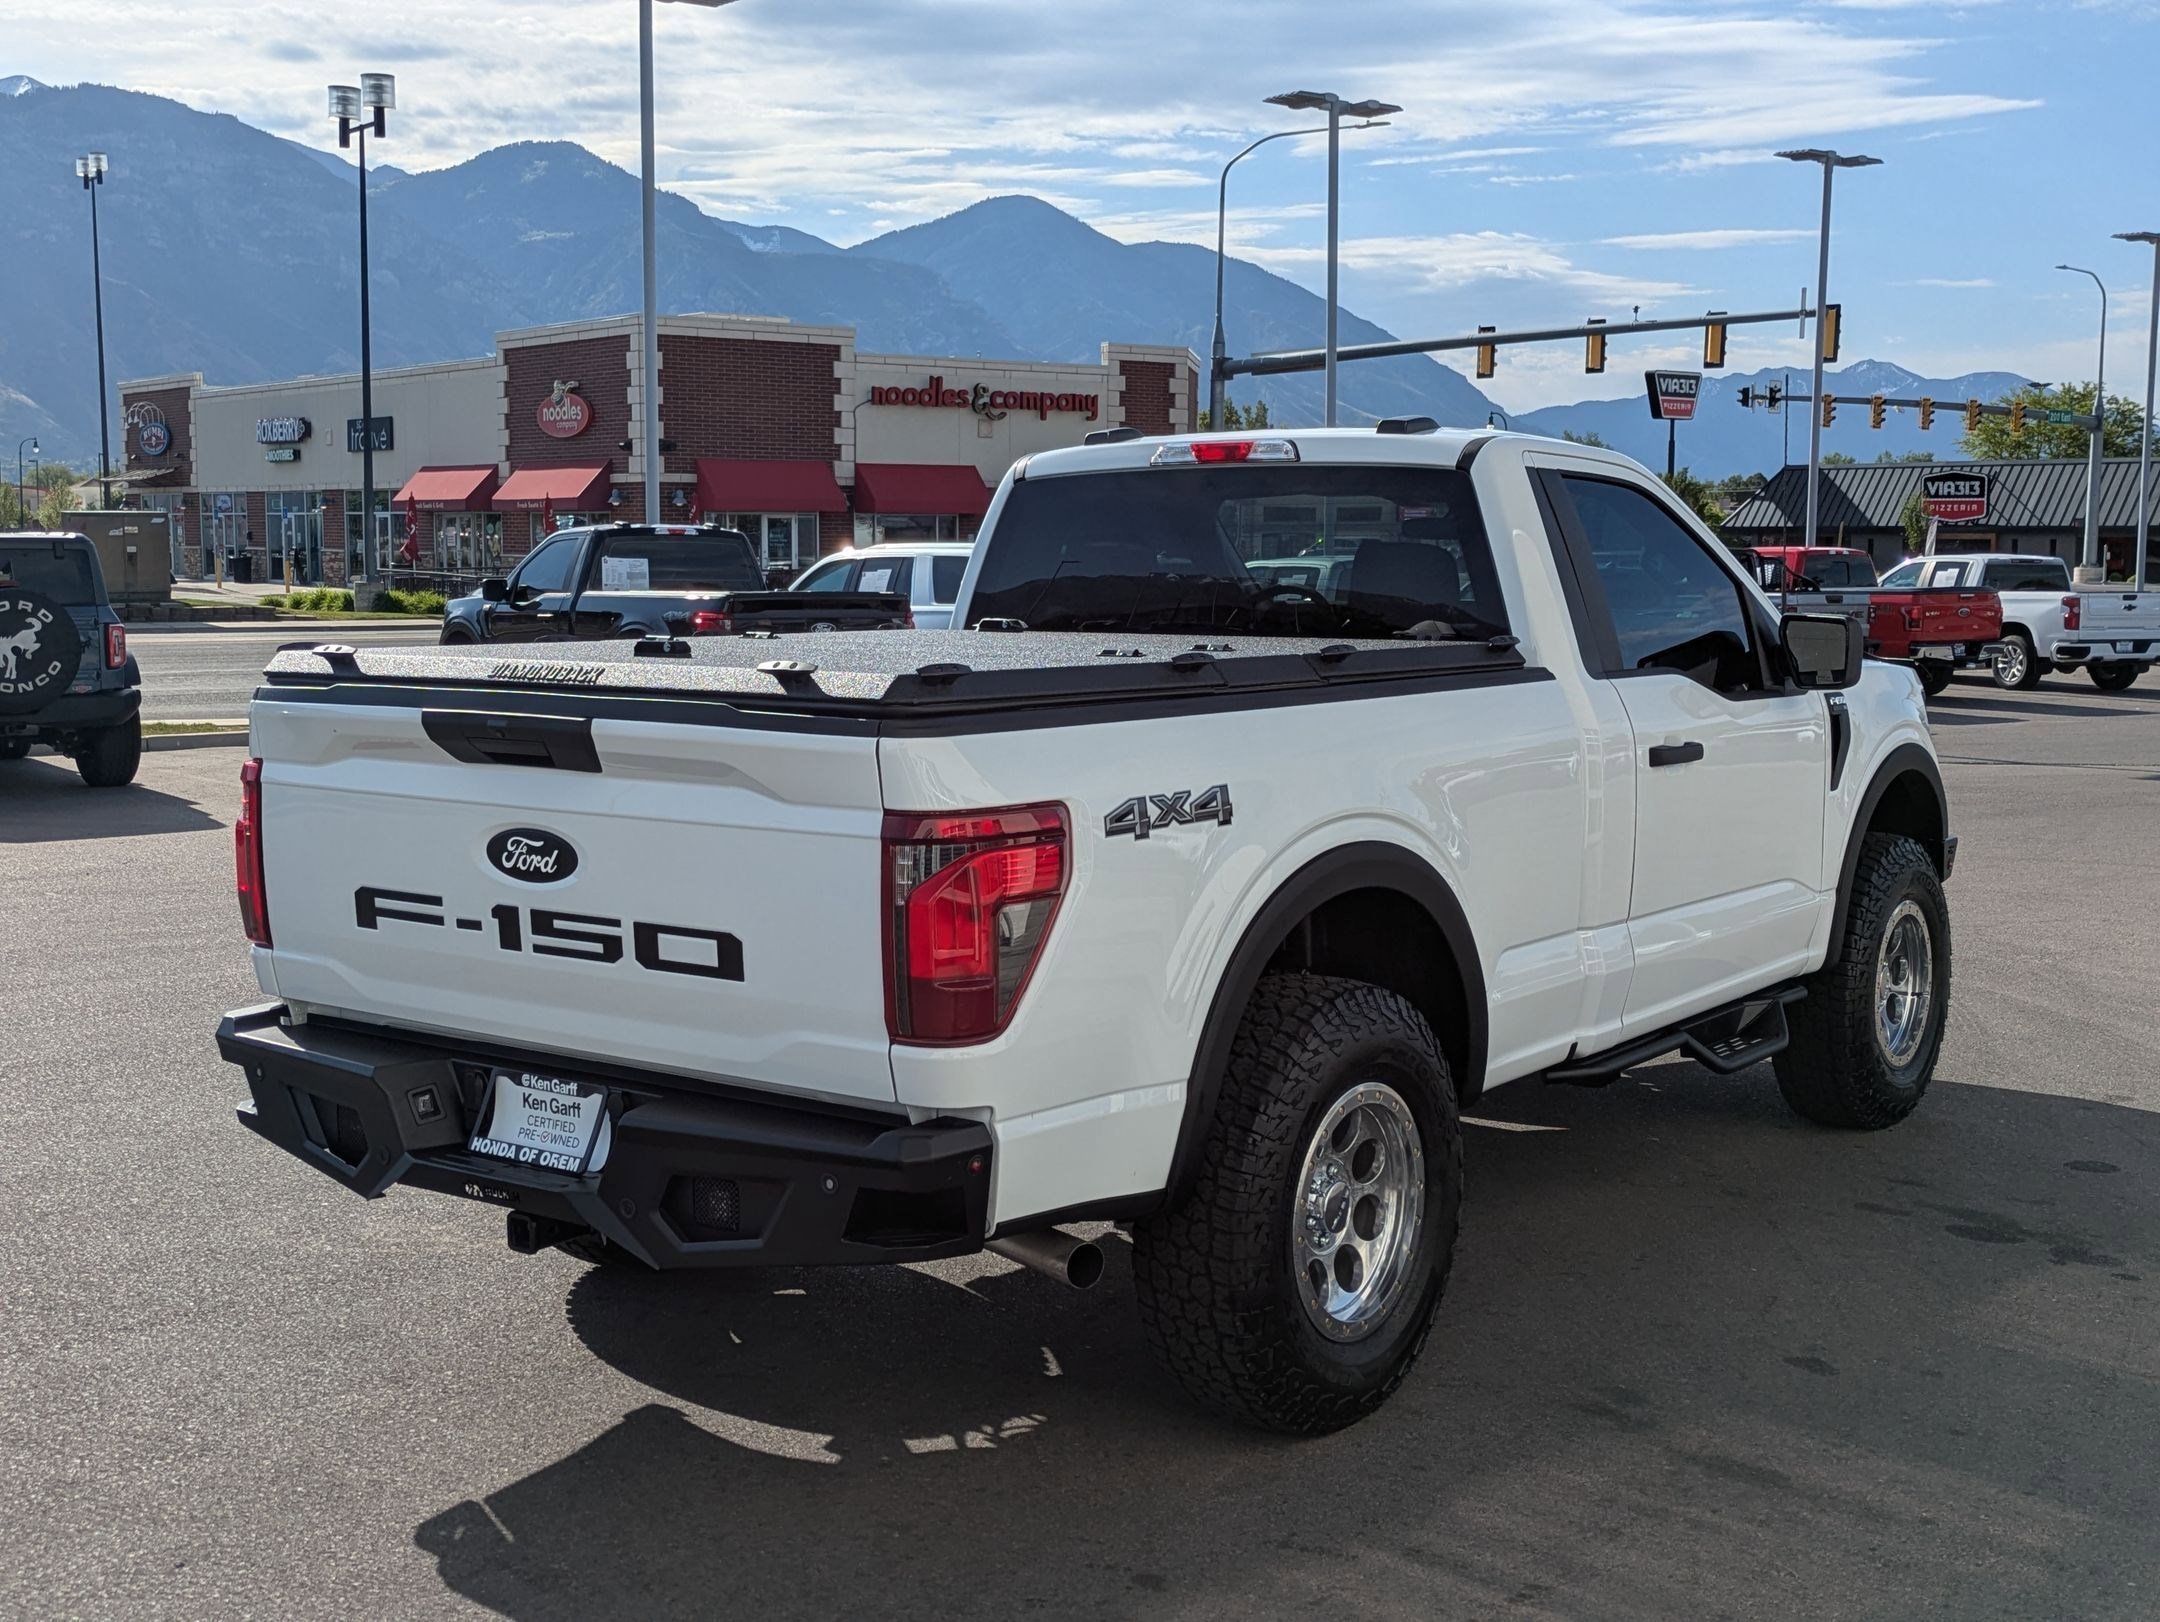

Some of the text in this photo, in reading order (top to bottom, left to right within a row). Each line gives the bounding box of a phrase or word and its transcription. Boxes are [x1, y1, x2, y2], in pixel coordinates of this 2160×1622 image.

[543, 397, 582, 421] noodles
[871, 375, 1099, 421] noodles & company
[256, 417, 299, 442] ROXBERRY
[1926, 480, 1981, 496] VIA313
[1929, 504, 1978, 512] PIZZERIA
[0, 600, 54, 623] ORD
[0, 660, 62, 693] ONCO
[501, 836, 559, 875] Ford
[354, 886, 745, 983] F-150
[530, 1075, 578, 1096] Ken Garff
[522, 1092, 582, 1118] Ken Garff
[527, 1115, 576, 1134] CERTIFIED
[471, 1137, 517, 1159] HONDA
[519, 1147, 539, 1162] OF
